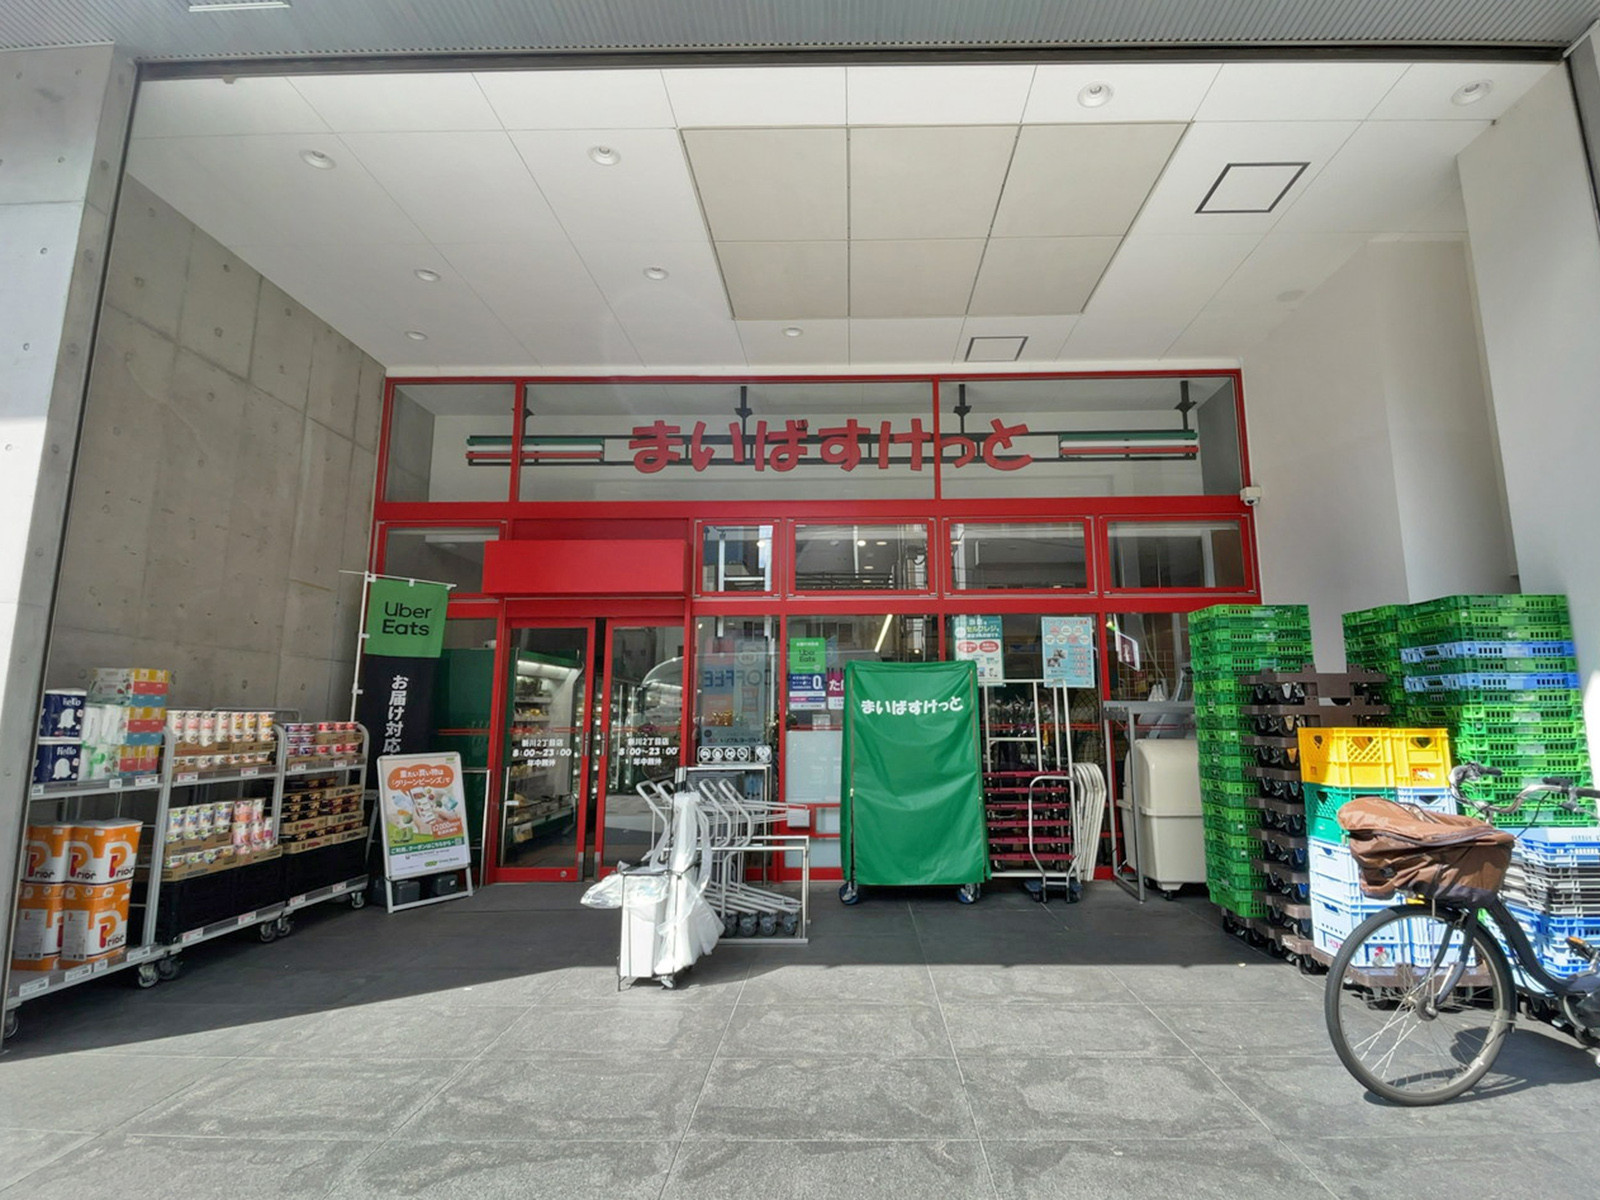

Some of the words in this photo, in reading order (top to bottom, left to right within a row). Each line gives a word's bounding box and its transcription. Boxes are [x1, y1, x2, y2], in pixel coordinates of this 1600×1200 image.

[628, 418, 1033, 474] まいばすけっと
[384, 601, 432, 619] Uber
[382, 619, 430, 636] Eats
[383, 674, 409, 755] お届け対応
[861, 696, 964, 716] まいばすけっと
[69, 846, 97, 880] Prior
[109, 846, 134, 878] Prior
[99, 914, 124, 948] Prior
